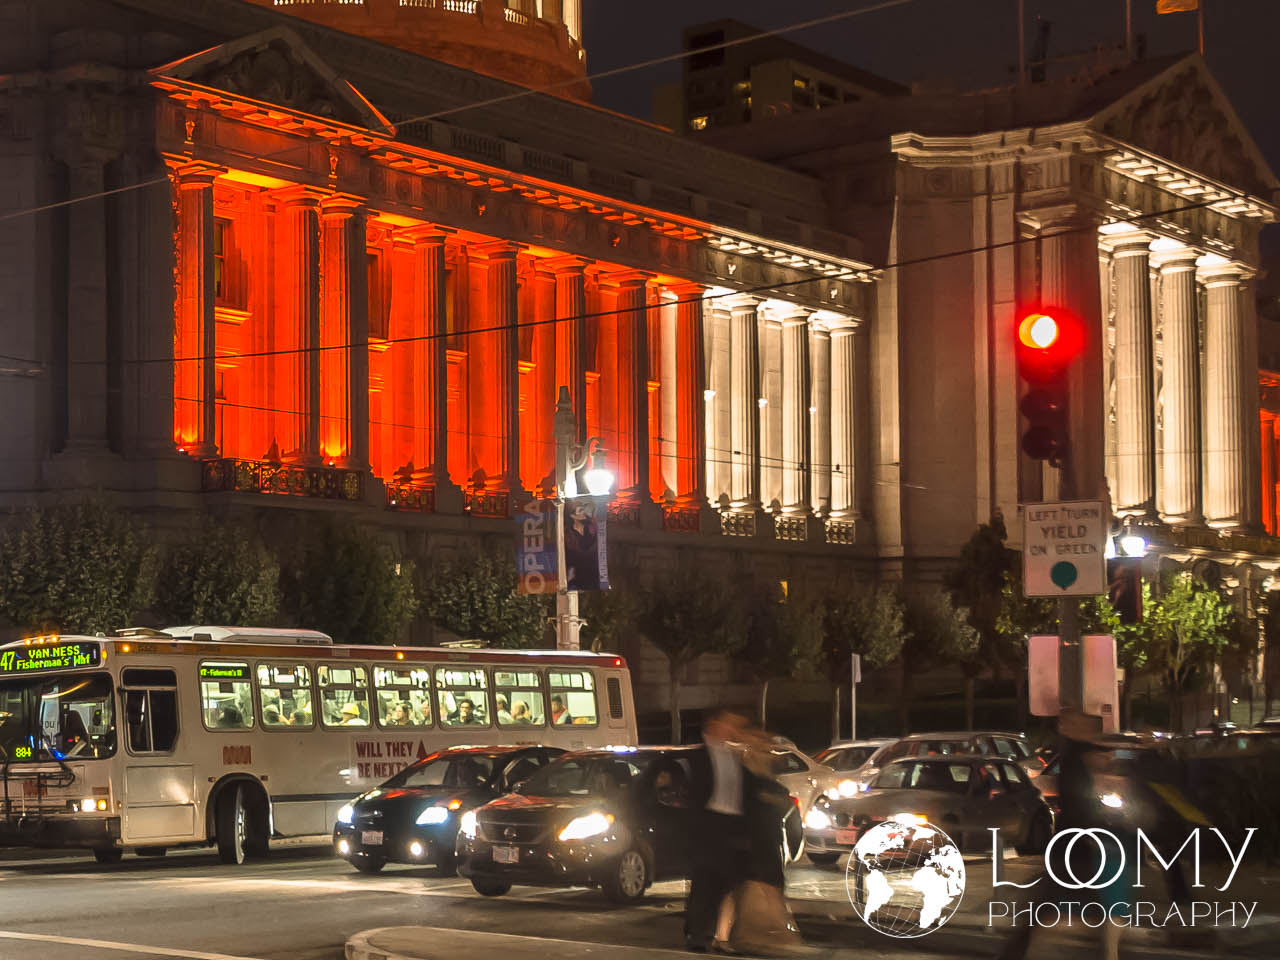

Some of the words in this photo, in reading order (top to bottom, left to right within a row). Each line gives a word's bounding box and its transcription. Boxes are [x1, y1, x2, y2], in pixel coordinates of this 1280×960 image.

[1029, 511, 1057, 522] LEFT
[1065, 508, 1099, 520] TURN
[1040, 525, 1088, 539] YIELD
[524, 499, 546, 594] OPERA
[1030, 545, 1047, 556] ON
[1056, 544, 1097, 555] GREEN
[0, 651, 16, 671] 47
[28, 648, 49, 659] VAN
[52, 645, 80, 657] NESS
[16, 657, 70, 670] Fisherman's
[355, 741, 383, 758] WILL
[385, 741, 414, 757] THEY
[357, 762, 371, 778] BE
